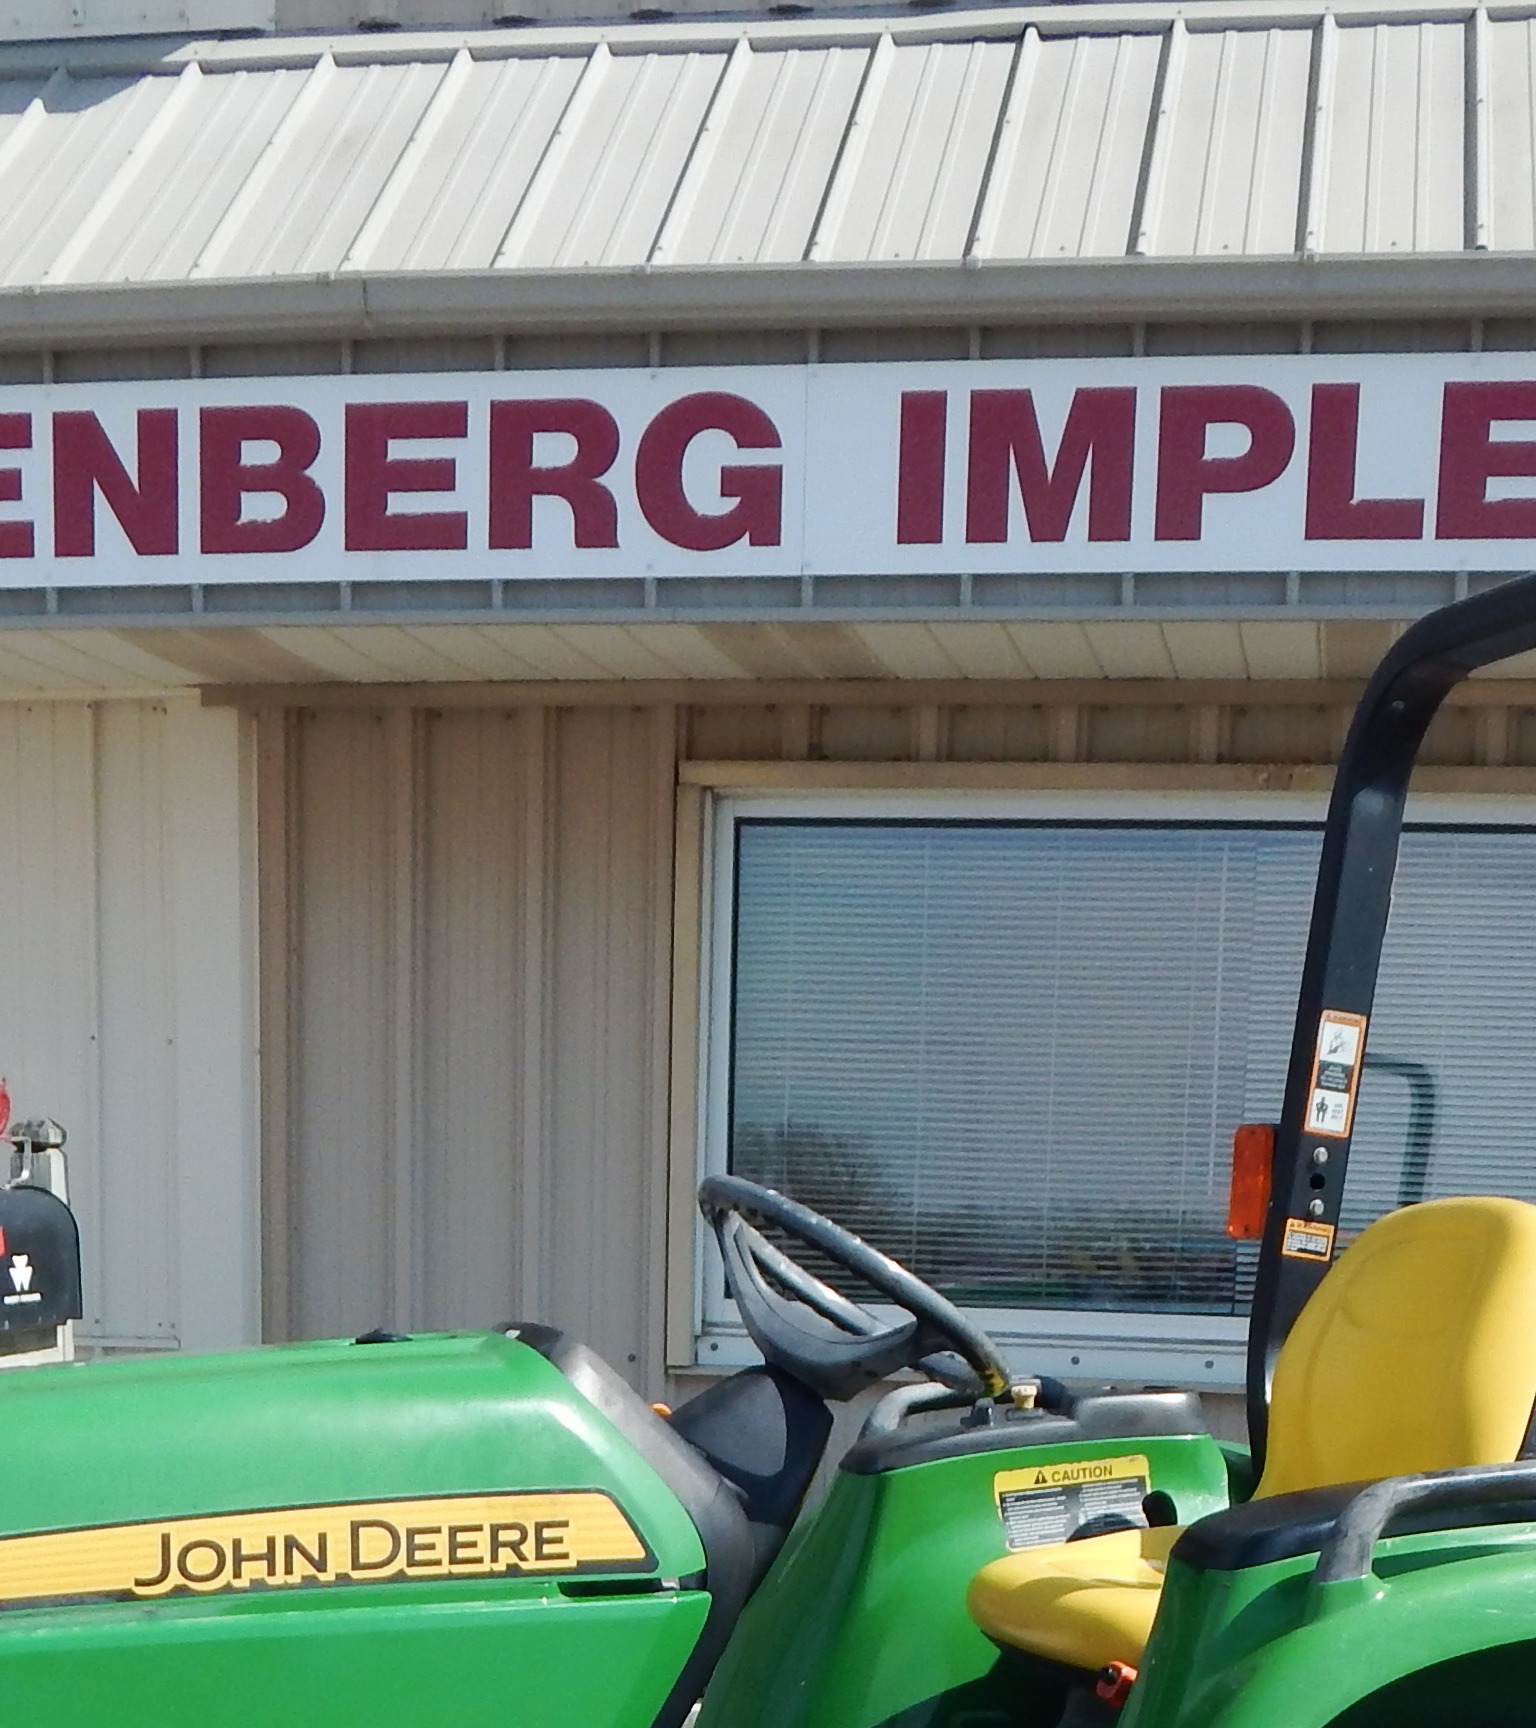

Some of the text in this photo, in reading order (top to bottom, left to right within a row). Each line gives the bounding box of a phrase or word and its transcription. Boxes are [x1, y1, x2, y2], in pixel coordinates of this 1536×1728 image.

[1050, 1464, 1114, 1484] CAUTION
[132, 1517, 571, 1590] JOHN DEERE
